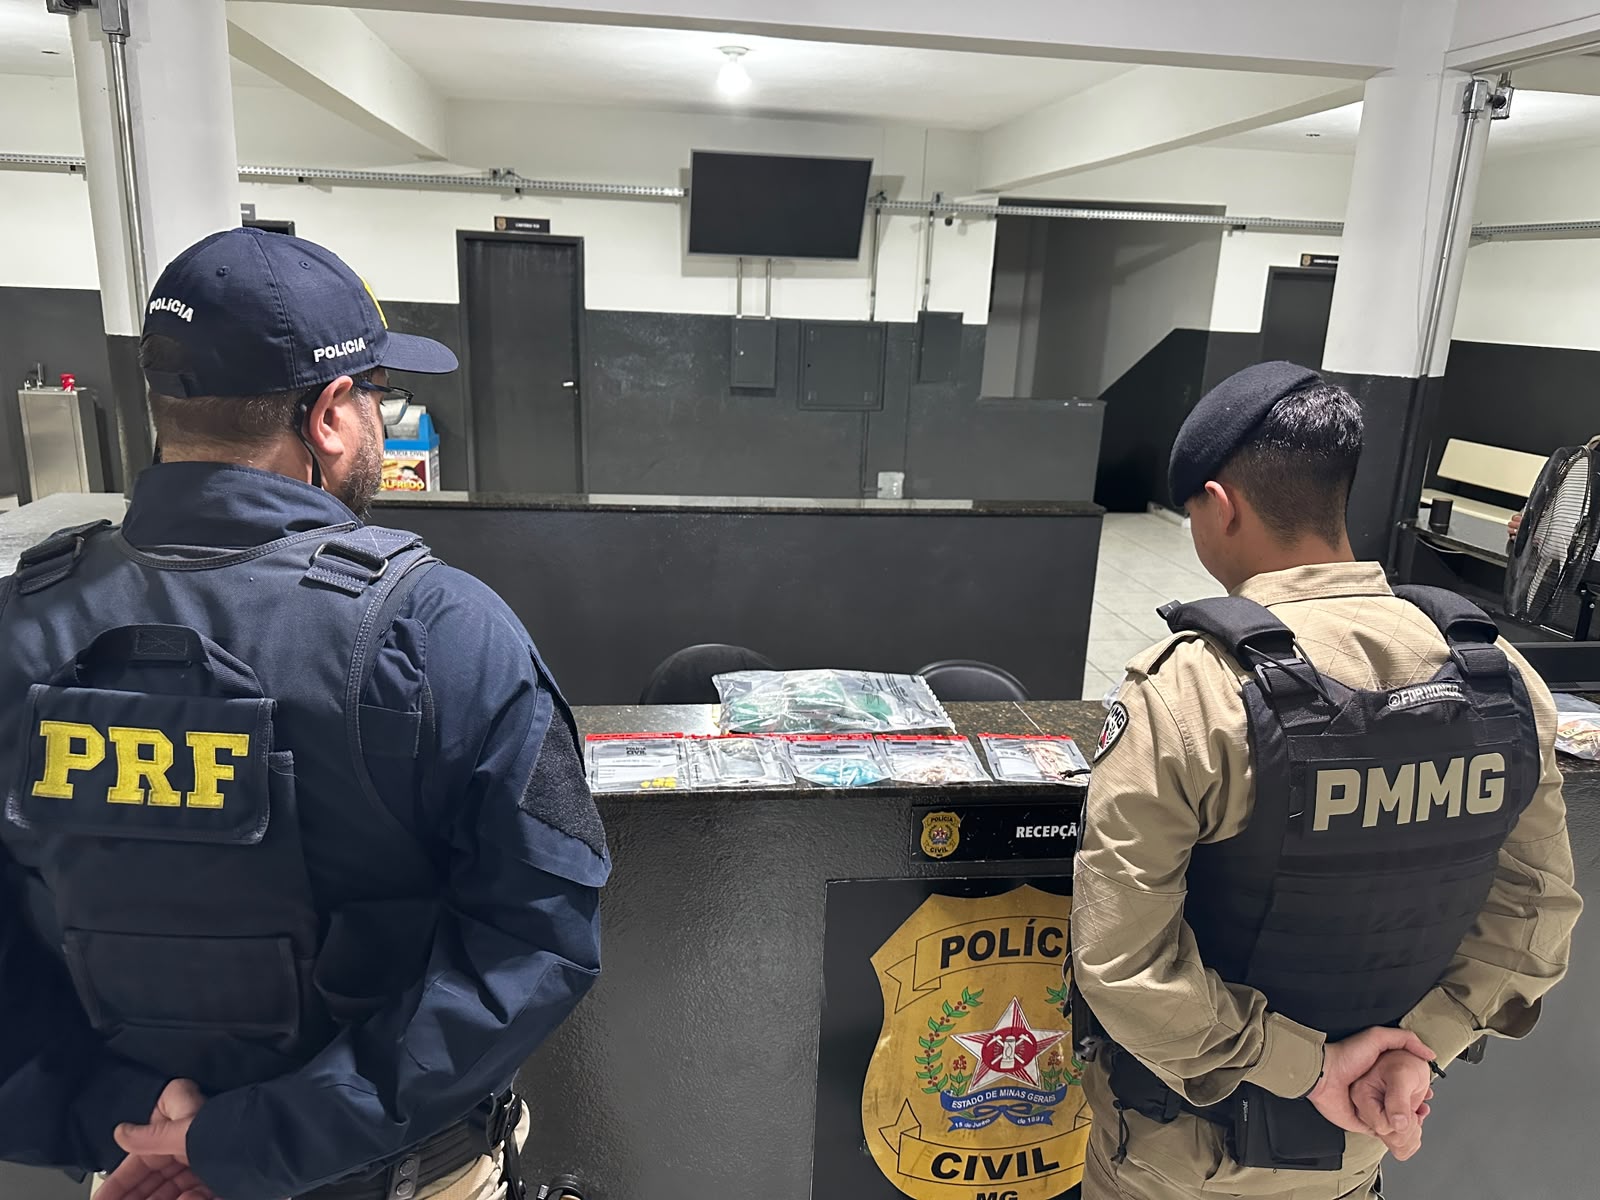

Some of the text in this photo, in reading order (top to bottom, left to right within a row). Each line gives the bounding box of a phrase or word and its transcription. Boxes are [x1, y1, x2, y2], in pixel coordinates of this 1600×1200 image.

[31, 720, 250, 808] PRF
[1312, 752, 1506, 831] PMMG
[1016, 822, 1080, 839] RECEPÇÃ
[952, 1089, 1056, 1109] ESTADO DE MINAS GERAIS
[930, 1147, 1060, 1181] CIVIL
[976, 1190, 1018, 1200] MG
